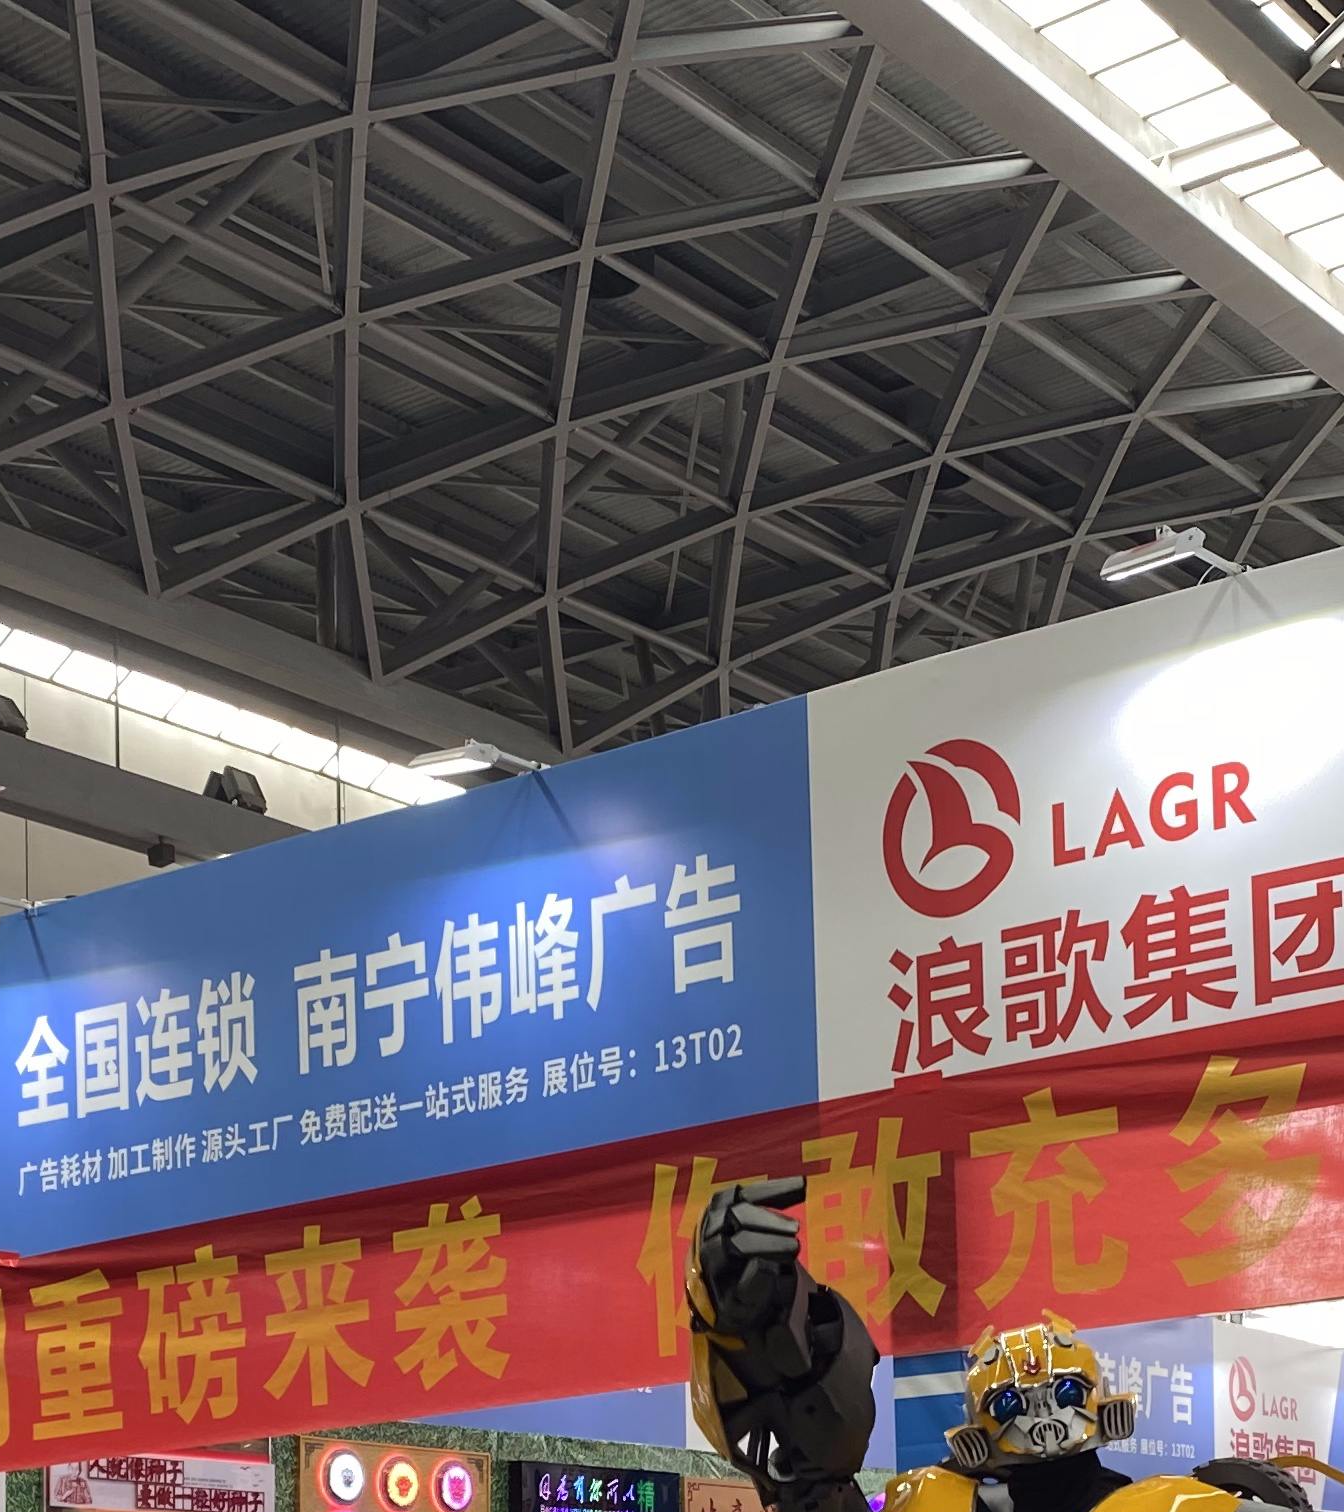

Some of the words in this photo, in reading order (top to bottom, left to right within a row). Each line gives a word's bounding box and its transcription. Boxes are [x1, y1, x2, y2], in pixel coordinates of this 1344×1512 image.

[1052, 761, 1257, 867] LAGR
[15, 970, 258, 1128] 全国连锁
[294, 854, 742, 1076] 南宁伟峰广告
[18, 1138, 102, 1196] 广告耗材
[107, 1131, 197, 1182] 加工制作
[201, 1113, 300, 1163] 源头工厂
[300, 1066, 530, 1146] 免费配送一站式服务
[1261, 1392, 1298, 1421] LAGR
